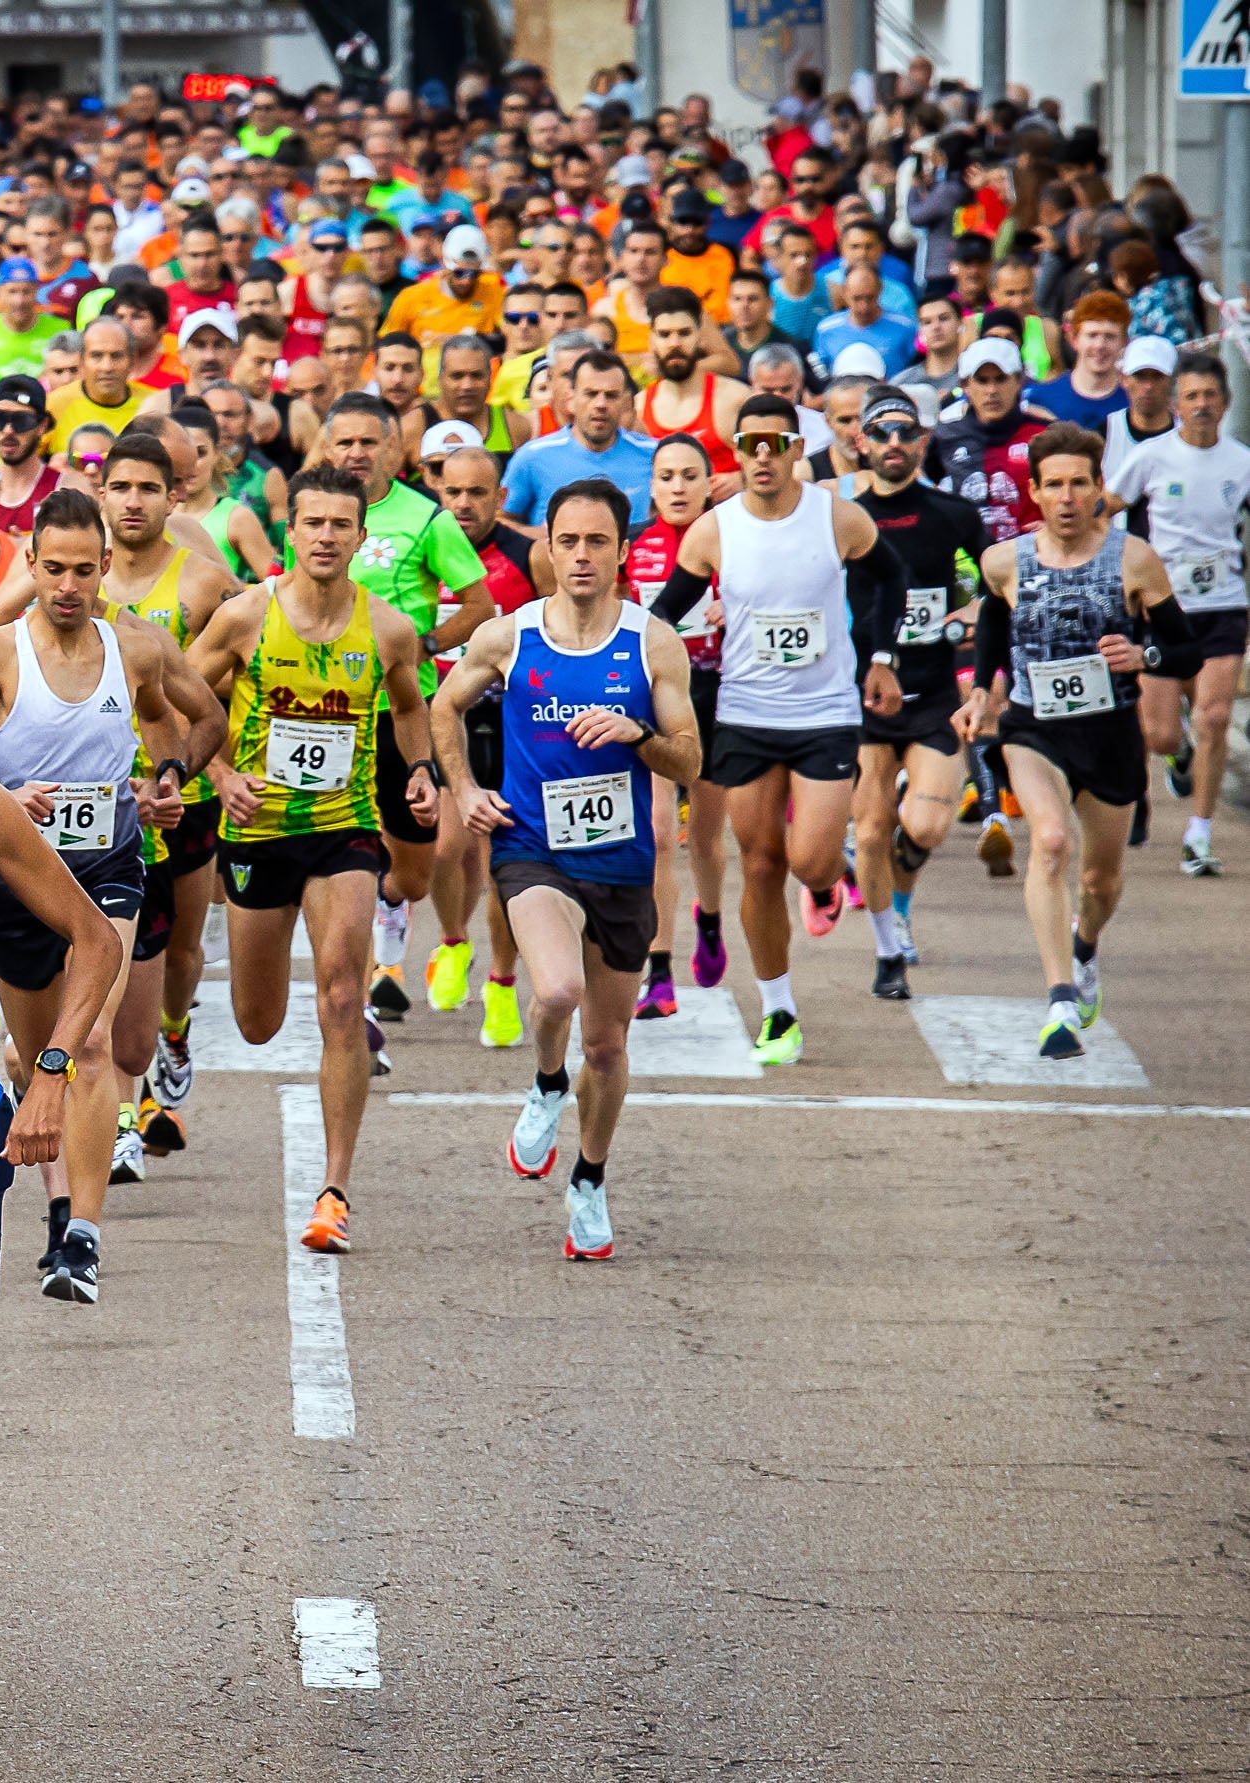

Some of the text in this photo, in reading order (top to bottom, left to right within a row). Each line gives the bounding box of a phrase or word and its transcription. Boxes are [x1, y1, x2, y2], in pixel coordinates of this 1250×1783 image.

[765, 627, 808, 649] 129
[1053, 675, 1084, 698] 96
[289, 744, 326, 770] 49
[562, 795, 613, 826] 140
